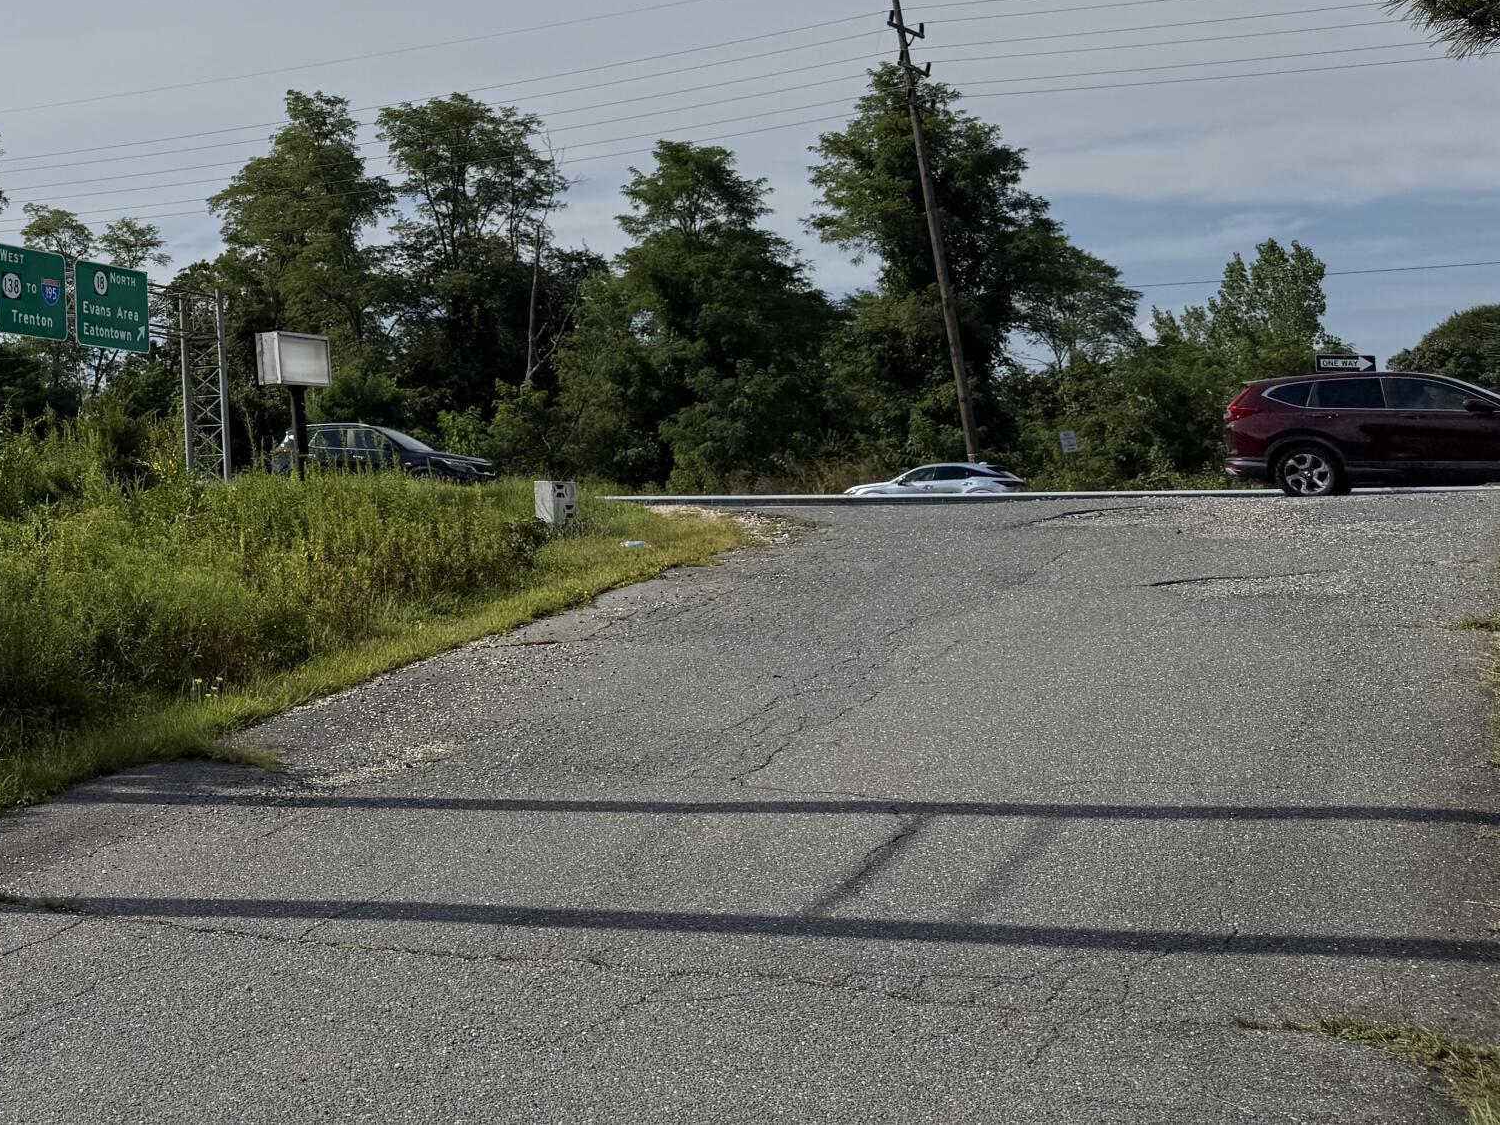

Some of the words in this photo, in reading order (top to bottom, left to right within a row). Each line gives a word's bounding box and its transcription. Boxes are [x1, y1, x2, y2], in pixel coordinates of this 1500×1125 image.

[0, 248, 25, 264] WEST
[4, 277, 19, 294] 138
[26, 283, 37, 294] TO
[45, 286, 57, 300] 195
[96, 276, 105, 291] 18
[109, 271, 136, 287] NORTH
[11, 309, 53, 328] Trenton
[82, 300, 112, 317] Evans
[116, 306, 139, 322] Area
[83, 322, 132, 341] Eatontown
[1322, 359, 1339, 367] ONE
[1341, 359, 1358, 367] WAY
